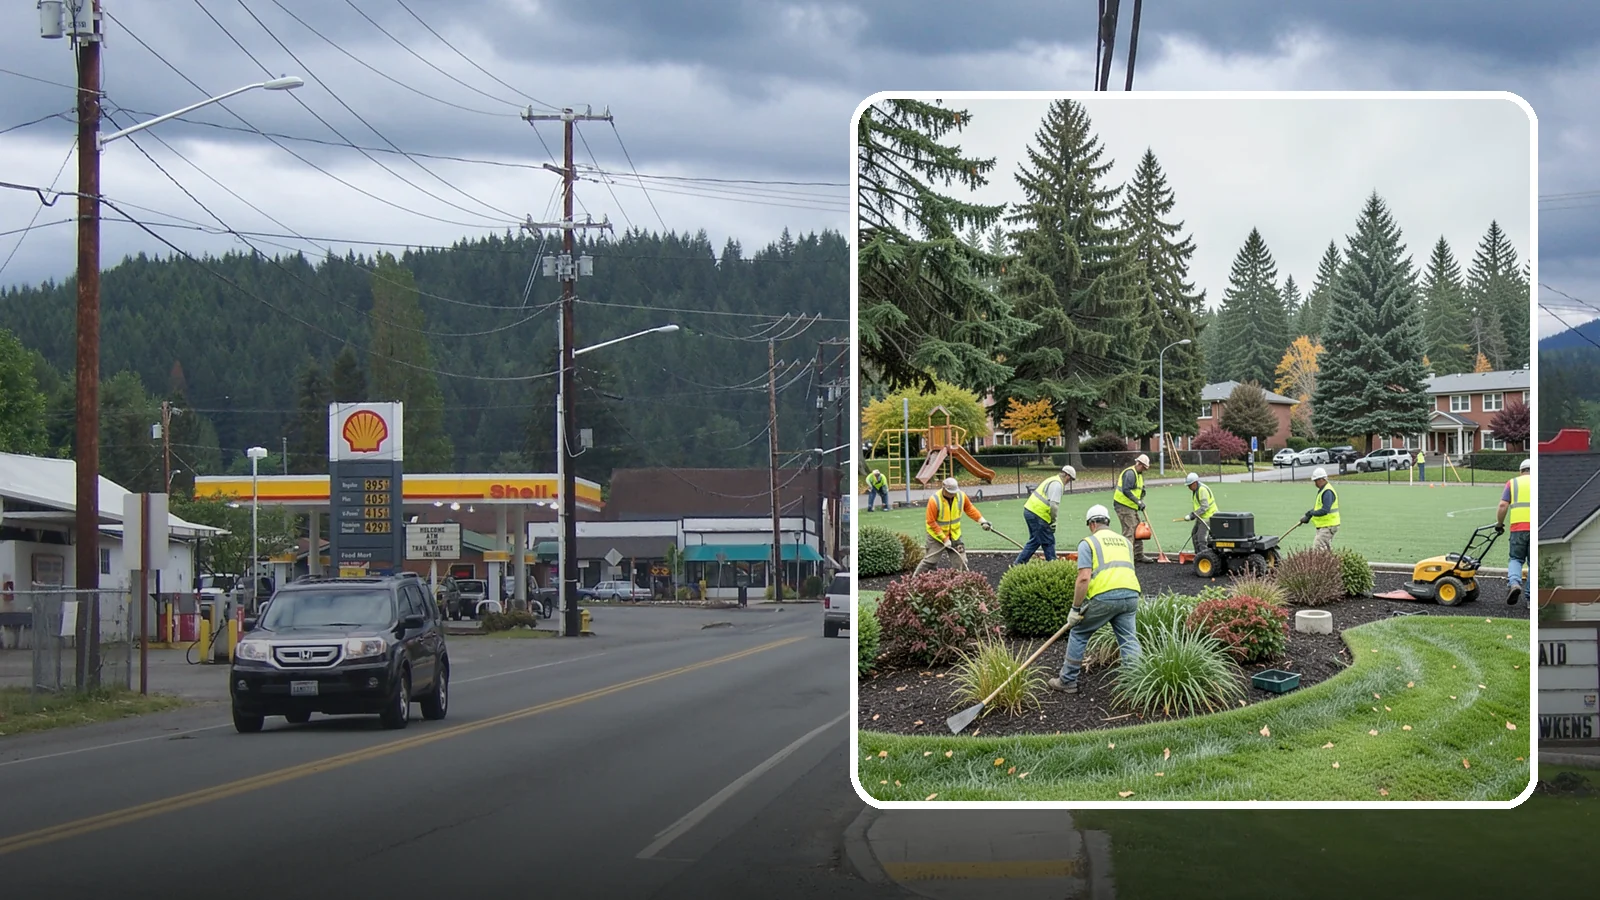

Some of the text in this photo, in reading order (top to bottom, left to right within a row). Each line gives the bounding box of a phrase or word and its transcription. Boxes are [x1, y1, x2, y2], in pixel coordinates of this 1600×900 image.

[366, 480, 383, 490] 395
[490, 484, 547, 499] Shell
[366, 494, 383, 504] 405
[366, 508, 383, 518] 415
[366, 522, 383, 533] 429
[1538, 643, 1566, 665] AID
